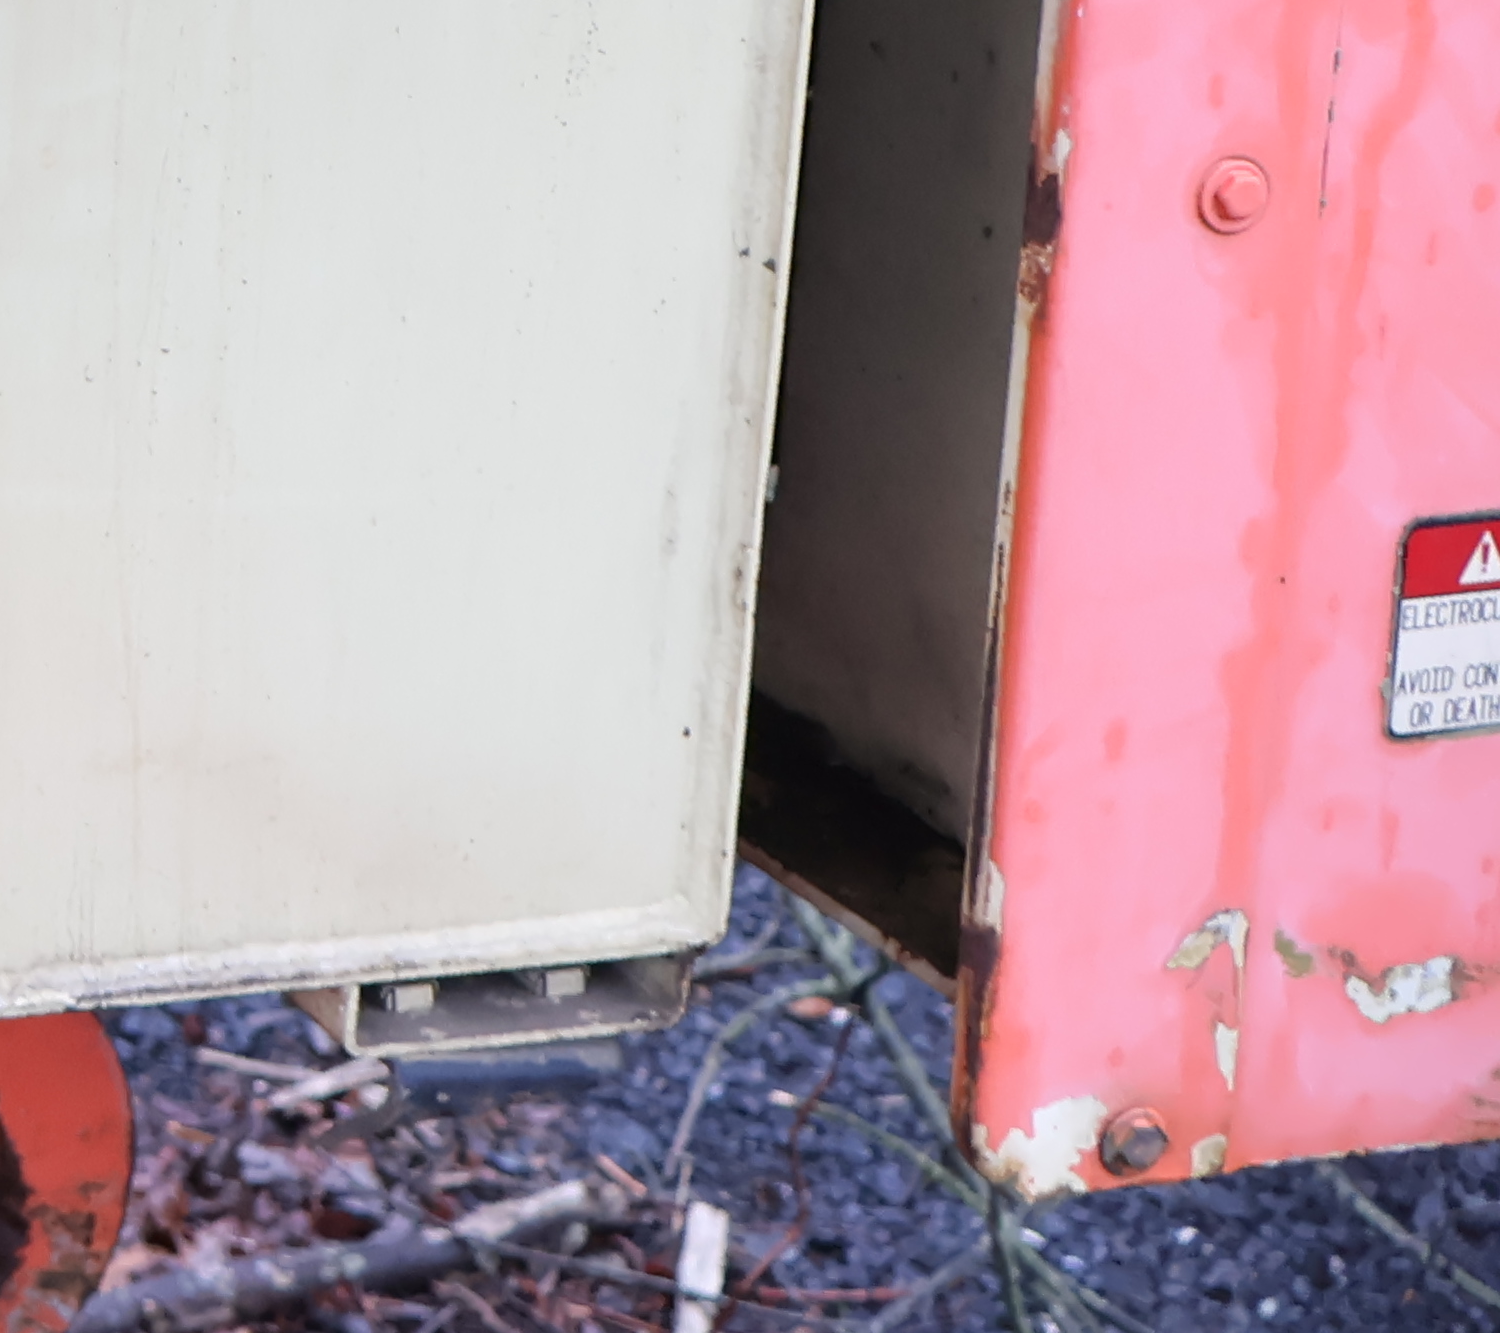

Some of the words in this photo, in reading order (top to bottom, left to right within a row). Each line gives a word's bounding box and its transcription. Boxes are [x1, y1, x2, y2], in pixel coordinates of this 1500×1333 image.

[1398, 666, 1455, 694] AVOID
[1410, 700, 1434, 727] OR
[1443, 694, 1500, 724] DEATH
